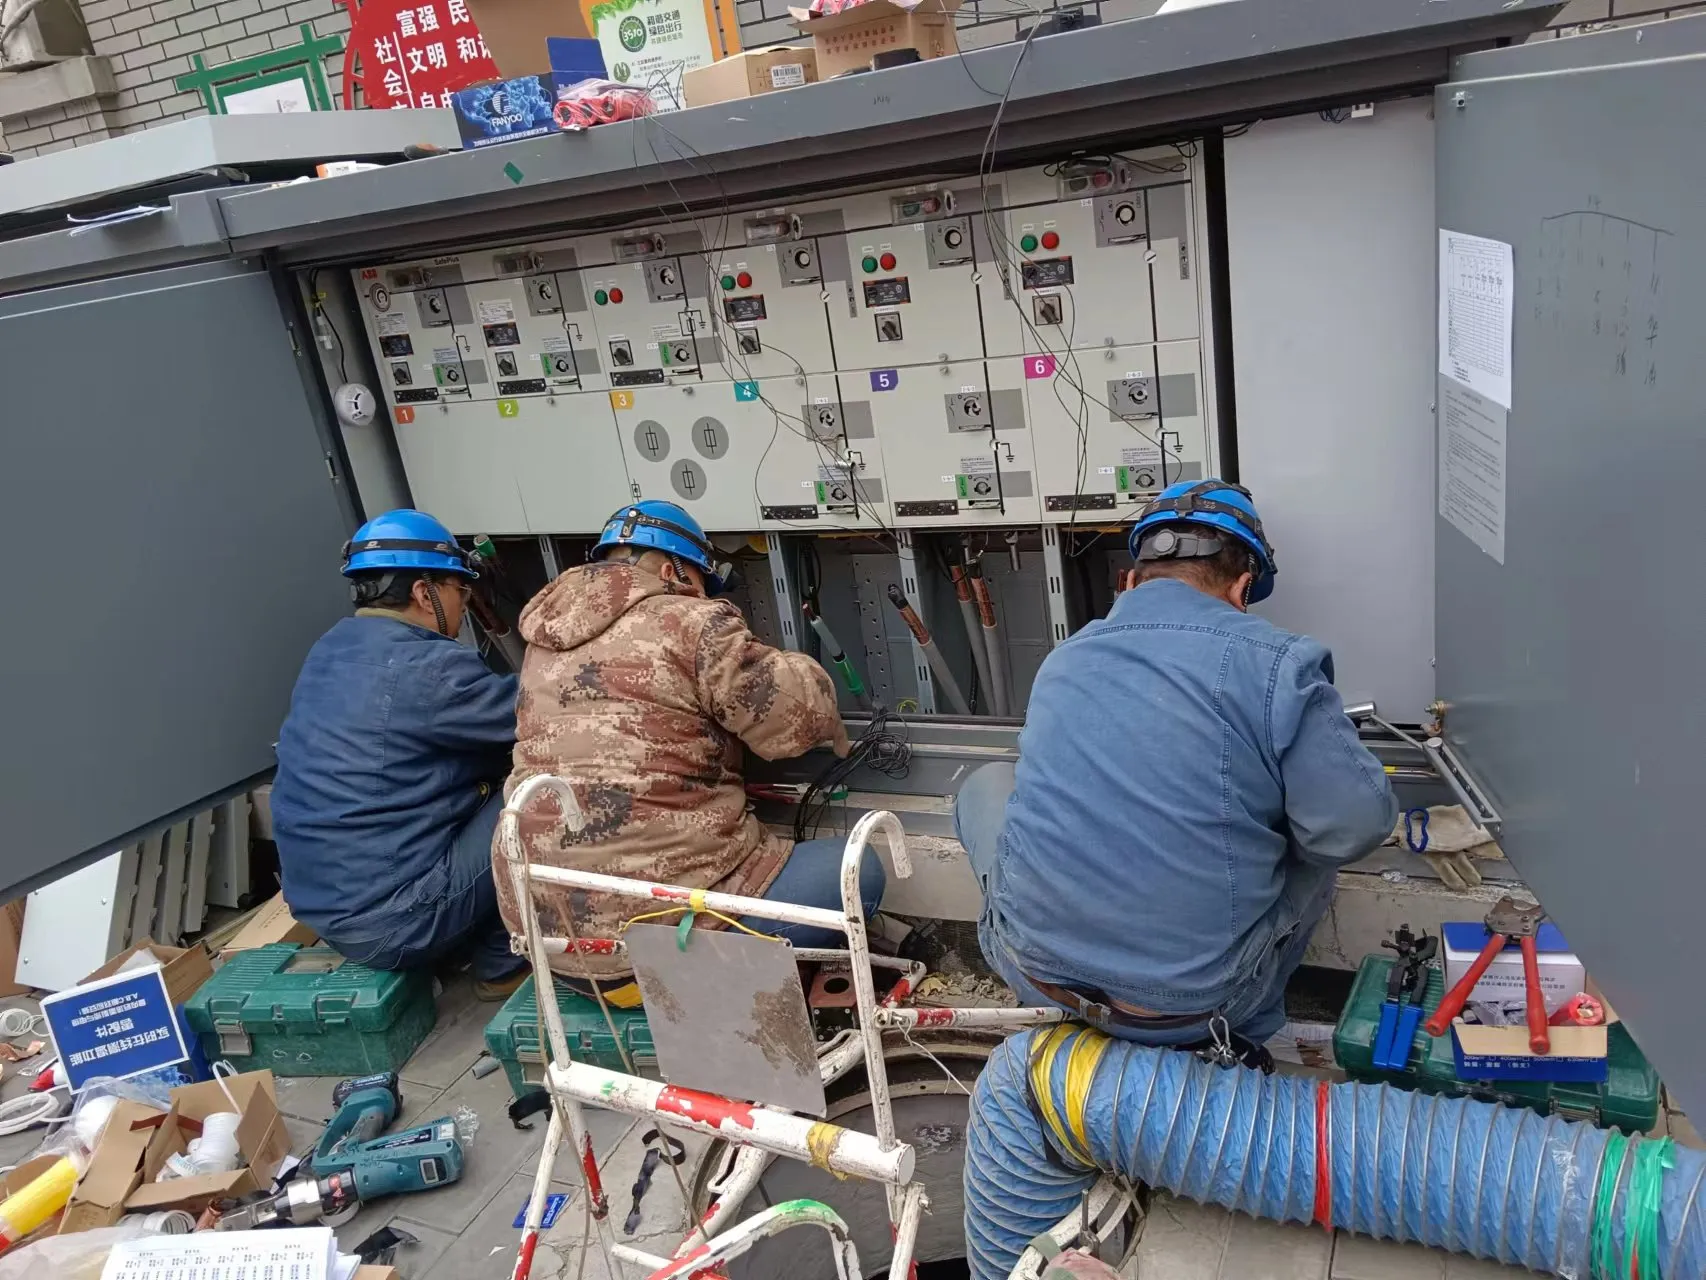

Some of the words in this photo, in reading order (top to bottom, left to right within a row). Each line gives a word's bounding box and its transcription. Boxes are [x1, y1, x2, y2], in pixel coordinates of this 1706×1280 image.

[396, 4, 440, 38] 富强
[646, 10, 681, 26] 和谐交通
[648, 20, 682, 36] 绿色出行
[406, 42, 448, 75] 文明
[491, 113, 523, 128] FANYOO
[1035, 360, 1045, 374] 6
[879, 374, 889, 387] 5
[744, 382, 752, 397] 4
[619, 395, 627, 406] 3
[401, 410, 409, 420] 1
[505, 403, 513, 415] 2
[94, 1018, 134, 1038] 零配件
[69, 1026, 170, 1066] 实时在线测温功能
